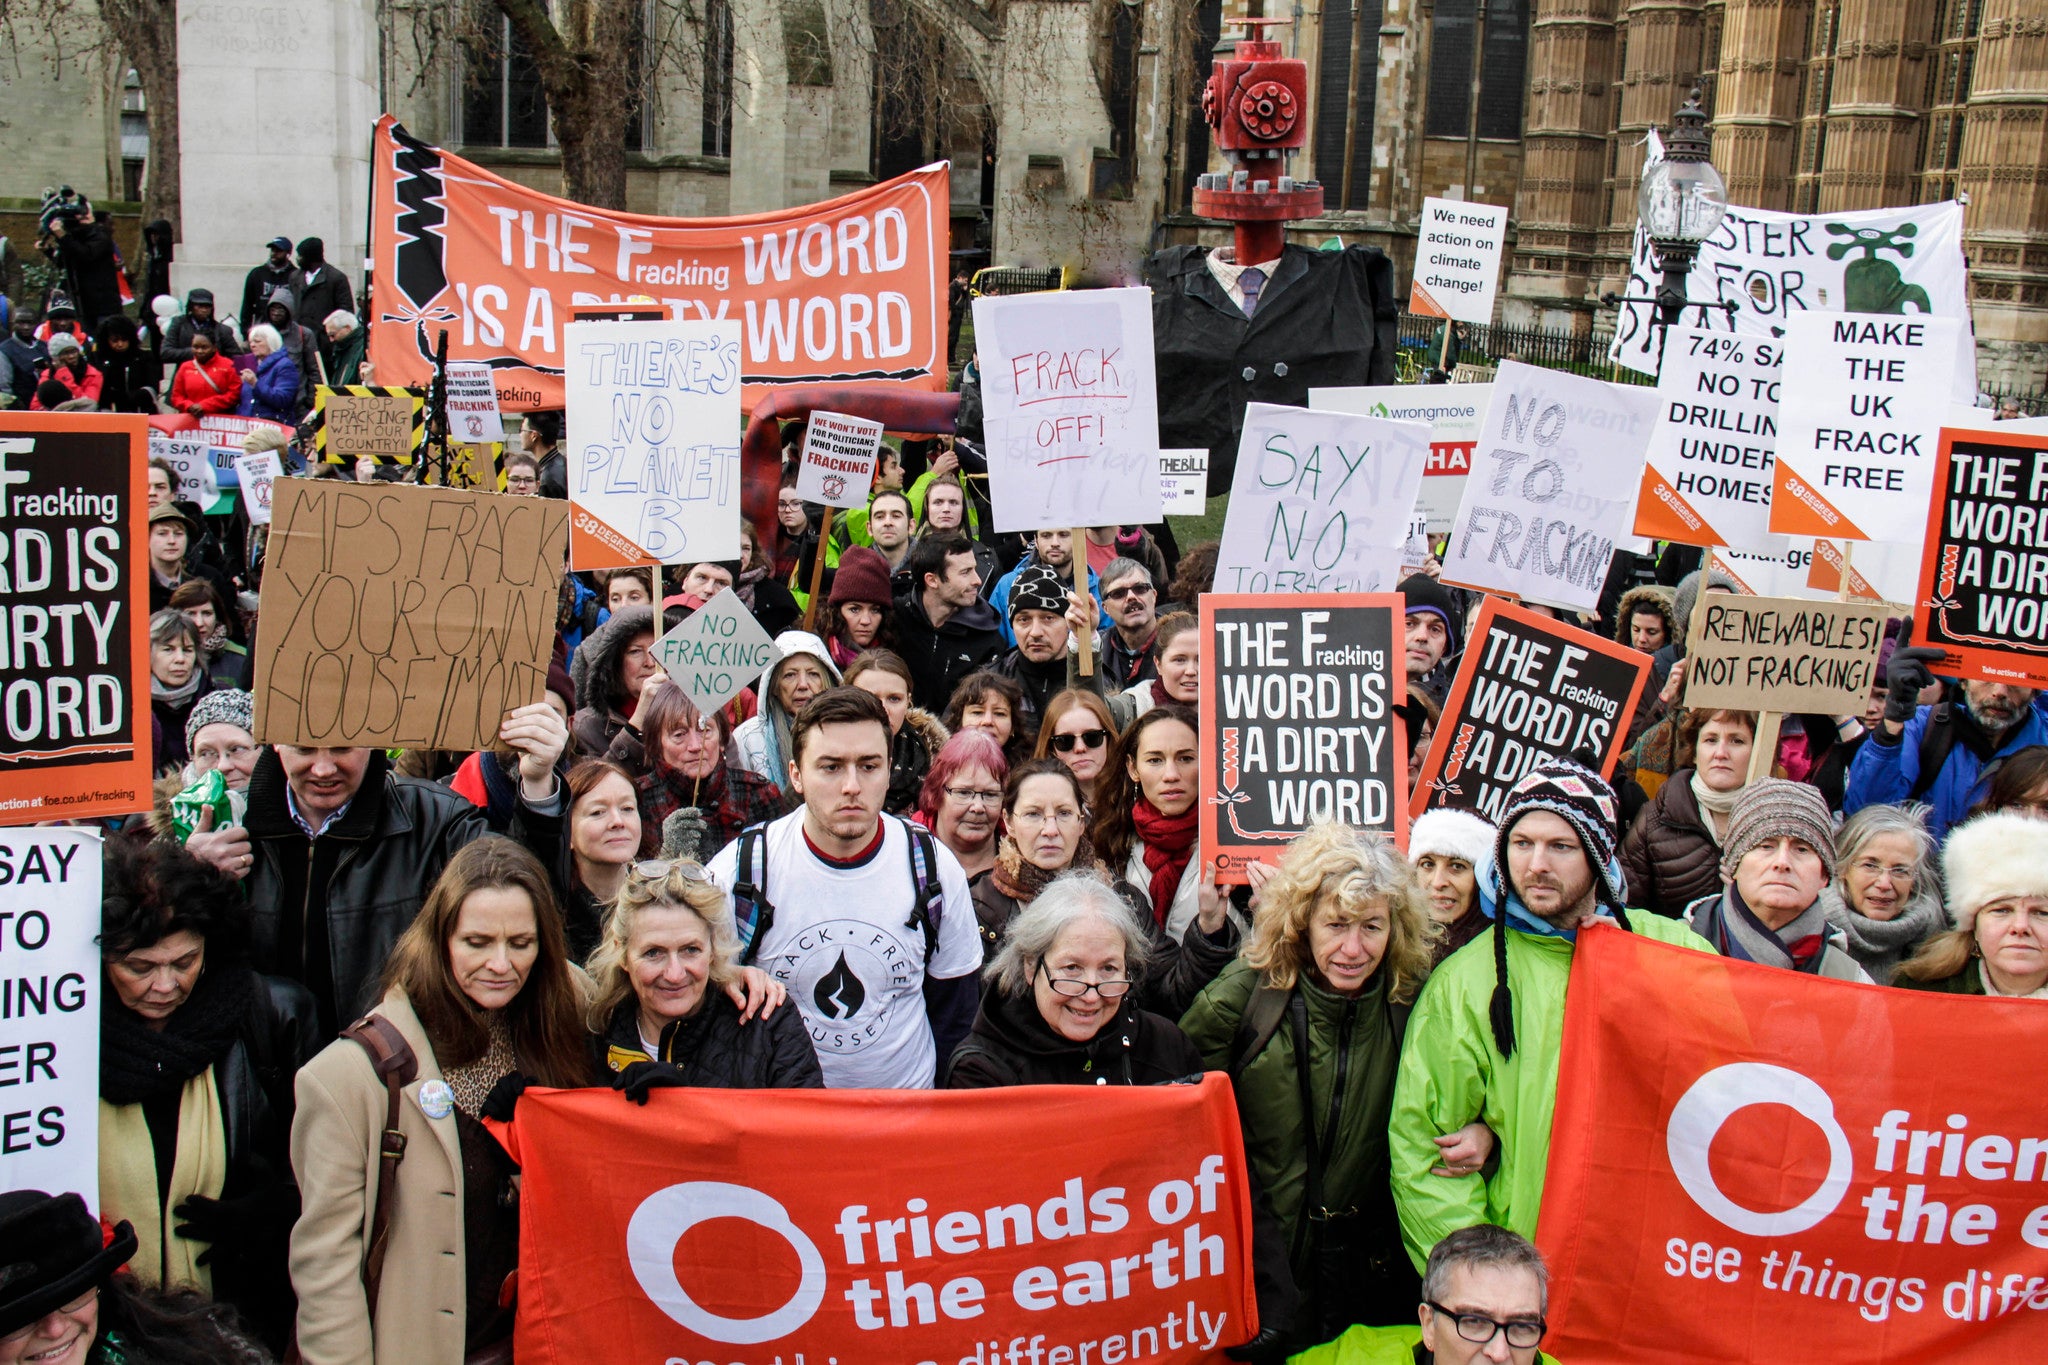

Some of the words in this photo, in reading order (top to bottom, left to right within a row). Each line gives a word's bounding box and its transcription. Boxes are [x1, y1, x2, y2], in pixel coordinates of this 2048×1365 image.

[1427, 232, 1471, 247] action
[1475, 239, 1494, 250] on
[1433, 208, 1456, 223] We
[1459, 215, 1495, 229] need
[488, 205, 595, 274] THE
[741, 208, 908, 285] WORD
[1430, 253, 1481, 270] climate
[1425, 274, 1484, 294] change!
[1714, 262, 1809, 319] FOR
[456, 282, 507, 347] IS
[520, 288, 555, 354] A
[744, 292, 911, 363] WORD
[1833, 320, 1925, 347] MAKE
[581, 335, 739, 394] THERE'S
[1012, 348, 1121, 395] FRACK
[1689, 335, 1743, 363] 74%
[1845, 357, 1906, 382] THE
[348, 397, 393, 411] STOP
[449, 401, 494, 411] FRACKING
[1697, 371, 1740, 396] NO
[1850, 394, 1893, 418] UK
[331, 409, 408, 426] FRACKING
[331, 425, 368, 436] WITH
[375, 425, 402, 437] OUR
[612, 393, 674, 445] NO
[814, 417, 828, 427] WE
[829, 420, 855, 433] WON'T
[857, 426, 878, 437] VOTE
[1036, 415, 1104, 448] OFF!
[1390, 406, 1475, 421] wrongmove
[1501, 393, 1567, 447] NO
[1669, 402, 1777, 437] DRILLIN
[170, 443, 201, 455] SAY
[810, 438, 831, 451] WHO
[832, 445, 873, 458] CONDONE
[811, 428, 827, 438] FOR
[827, 432, 876, 447] POLITICIANS
[1814, 428, 1922, 457] FRACK
[580, 444, 740, 506] PLANET
[807, 451, 870, 474] FRACKING
[1259, 434, 1370, 506] SAY
[1489, 448, 1565, 504] TO
[1824, 465, 1905, 492] FREE
[1951, 453, 2022, 499] THE
[1653, 483, 1672, 502] 38
[1669, 496, 1702, 529] DEGREES
[1784, 478, 1806, 498] 38
[1803, 491, 1839, 524] DEGREES
[276, 489, 402, 576] MPS
[416, 498, 570, 590] FRACK
[574, 512, 599, 535] 38
[597, 525, 642, 560] DEGREES
[637, 498, 687, 559] B
[1264, 501, 1348, 571] NO
[1459, 505, 1613, 594] FRACKING
[1816, 541, 1836, 562] 38
[66, 527, 120, 592] IS
[1228, 567, 1269, 592] TO
[1958, 546, 1983, 587] A
[1990, 550, 2048, 595] DIR
[0, 600, 121, 670] IRTY
[278, 571, 428, 657] YOUR
[434, 583, 547, 662] OWN
[701, 613, 737, 637] NO
[1703, 605, 1881, 655] RENEWABLES!
[663, 640, 771, 667] FRACKING
[1215, 621, 1289, 668] THE
[1301, 611, 1385, 671] Fracking
[694, 672, 733, 695] NO
[1484, 627, 1551, 688] THE
[1549, 644, 1619, 720] Fracking
[1693, 656, 1740, 687] NOT
[1746, 654, 1873, 700] FRACKING!
[1981, 665, 1996, 675] Take
[1997, 669, 2017, 678] action
[0, 674, 123, 742] ORD
[1222, 673, 1341, 720] WORD
[1350, 672, 1386, 720] IS
[1469, 676, 1574, 747] WORD
[1571, 713, 1611, 758] IS
[1243, 726, 1268, 774] A
[1277, 725, 1387, 774] DIRTY
[1465, 730, 1496, 775] A
[31, 796, 43, 808] at
[44, 789, 135, 806] foe.co.uk/fracking
[1268, 779, 1388, 826] WORD
[775, 928, 833, 980] RACK
[870, 934, 908, 985] FREE
[1, 972, 87, 1019] ING
[0, 1041, 59, 1088] ER
[2, 1105, 65, 1155] ES
[1873, 1109, 2048, 1182] frien
[835, 1176, 1130, 1265] friends
[1148, 1154, 1225, 1226] of
[1861, 1184, 1998, 1246] the
[844, 1269, 985, 1331] the
[1012, 1222, 1225, 1312] earth
[1664, 1237, 1742, 1284] see
[1760, 1250, 1927, 1323] things
[957, 1300, 1227, 1365] differently
